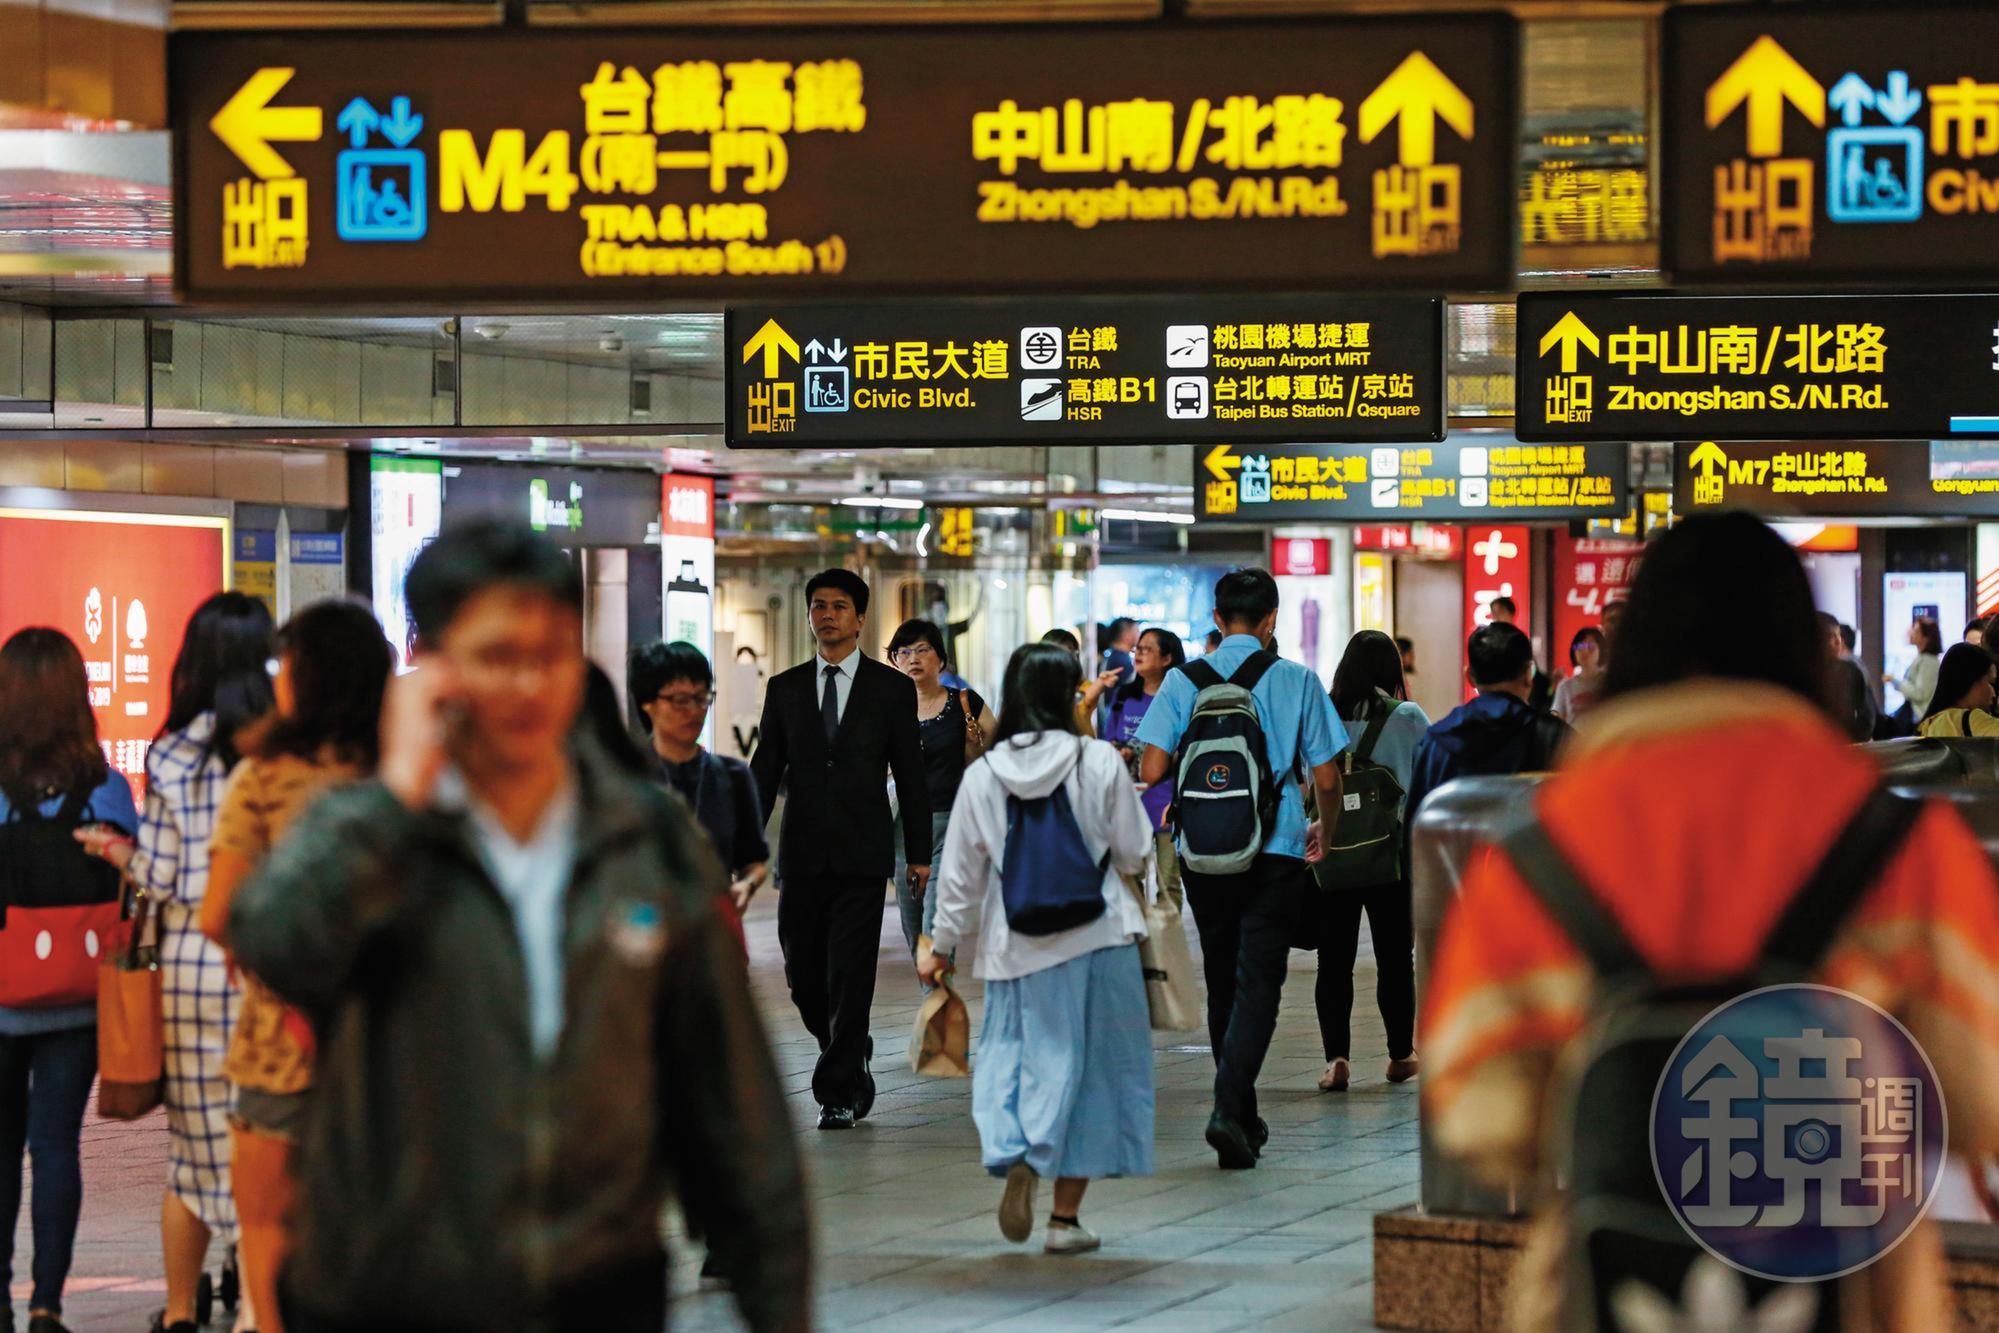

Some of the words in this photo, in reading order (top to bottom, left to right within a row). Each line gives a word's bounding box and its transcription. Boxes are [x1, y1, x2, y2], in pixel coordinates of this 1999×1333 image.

[1927, 77, 1999, 158] 市
[972, 93, 1346, 174] 中山南/北路
[439, 129, 576, 212] M4
[977, 180, 1187, 228] Zhongshan
[1373, 163, 1460, 256] 出口
[1715, 159, 1813, 262] 出口
[222, 178, 309, 269] 出口
[580, 204, 654, 239] TRA
[657, 206, 687, 239] &
[688, 204, 768, 239] HSR
[1068, 326, 1117, 351] 台鐵
[1213, 323, 1369, 349] 桃園機場捷運
[1609, 323, 1888, 375] 中山南/北路
[854, 340, 1008, 380] 市民大道
[1068, 356, 1100, 369] TRA
[1213, 354, 1275, 370] Taoyuan
[1279, 353, 1331, 368] Airport
[1335, 352, 1370, 365] MRT
[854, 389, 911, 408] Civic
[919, 388, 975, 407] Blvd.
[1068, 377, 1155, 403] 高鐵B1
[1546, 376, 1592, 423] 出口
[1608, 385, 1765, 415] Zhongshan
[748, 382, 795, 433] 出口
[1068, 407, 1101, 420] HSR
[1213, 405, 1256, 421] Taipei
[1260, 405, 1288, 418] Bus
[1292, 404, 1344, 417] Station
[1357, 403, 1420, 419] Qsquare
[1569, 410, 1592, 422] EXIT
[772, 419, 795, 431] EXIT
[1271, 456, 1367, 483] 市民大道
[1728, 460, 1770, 487] M7
[1772, 452, 1867, 477] 中山北路
[1694, 475, 1724, 504] 出口
[1772, 478, 1846, 495] Zhongshan
[1848, 478, 1863, 492] N.
[1864, 477, 1888, 492] Rd.
